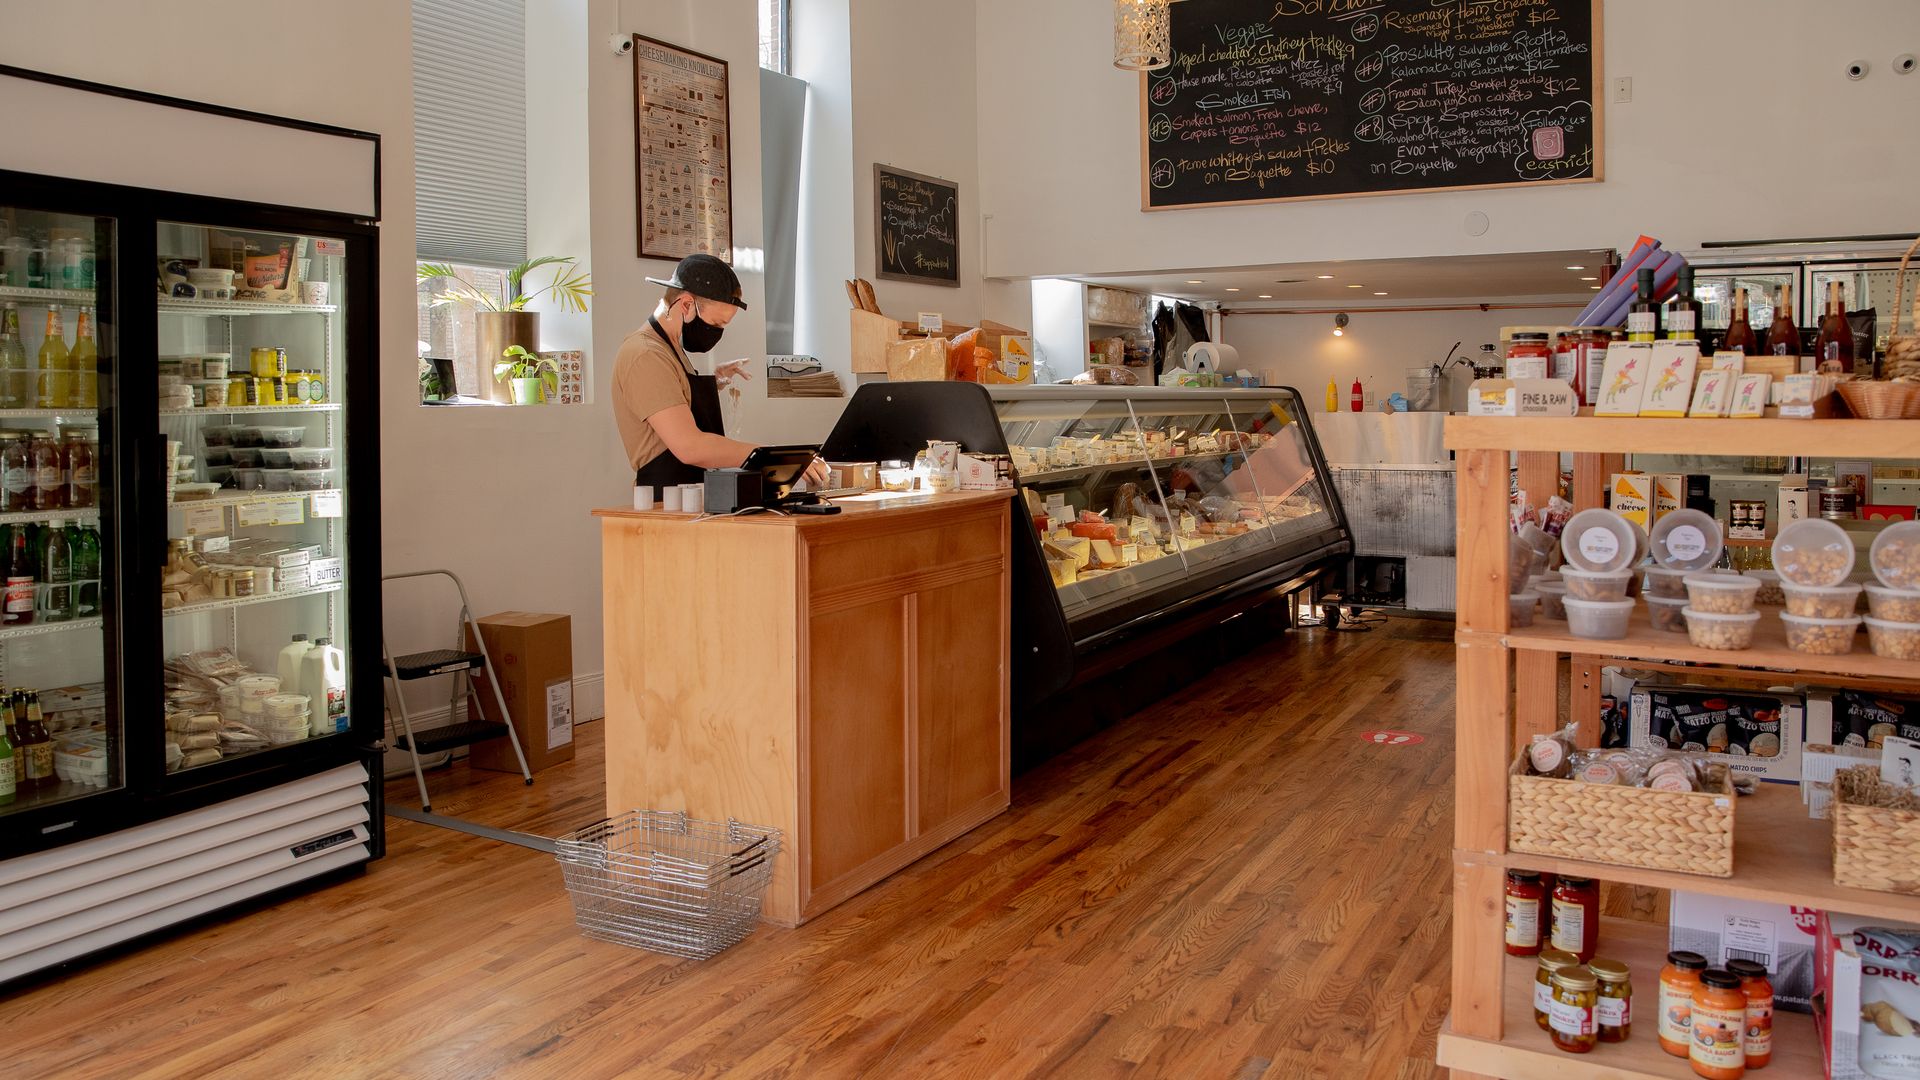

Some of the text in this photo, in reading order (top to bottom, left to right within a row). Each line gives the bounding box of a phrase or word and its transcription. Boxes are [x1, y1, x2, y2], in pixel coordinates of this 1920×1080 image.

[1383, 8, 1455, 30] Rosemary
[1456, 1, 1490, 20] Ham
[1526, 8, 1560, 27] $12
[1215, 22, 1273, 48] Veggie
[638, 44, 688, 69] CHEESEMAKING
[688, 59, 725, 81] KNOWLEDGE
[1175, 44, 1206, 74] Aged
[1232, 59, 1246, 70] on
[1391, 63, 1451, 80] Kalamata
[1453, 55, 1482, 71] olives
[1486, 55, 1499, 65] or
[1502, 46, 1542, 64] roasted
[1450, 69, 1466, 78] on
[1521, 59, 1561, 76] $12
[1151, 80, 1175, 100] #2
[1256, 62, 1289, 79] Fresh
[1322, 80, 1343, 96] $9
[1543, 76, 1581, 98] $12
[1195, 87, 1292, 113] Smoked Fish
[1151, 117, 1172, 137] #3
[1171, 110, 1215, 131] Smoked
[1253, 107, 1284, 122] Fresh
[1262, 122, 1277, 132] on
[1295, 119, 1323, 136] $12
[1355, 115, 1383, 138] #8
[1524, 115, 1588, 130] Follow us
[1266, 145, 1302, 161] salad
[1397, 144, 1427, 158] EVOO
[1203, 171, 1220, 185] on
[1305, 157, 1336, 177] $10
[1369, 163, 1387, 175] on
[1522, 393, 1567, 404] FINE & RAW
[1522, 405, 1548, 413] chocolate
[1616, 502, 1647, 513] cheese
[316, 566, 341, 581] BUTTER
[1730, 764, 1768, 774] MATZO CHIPS
